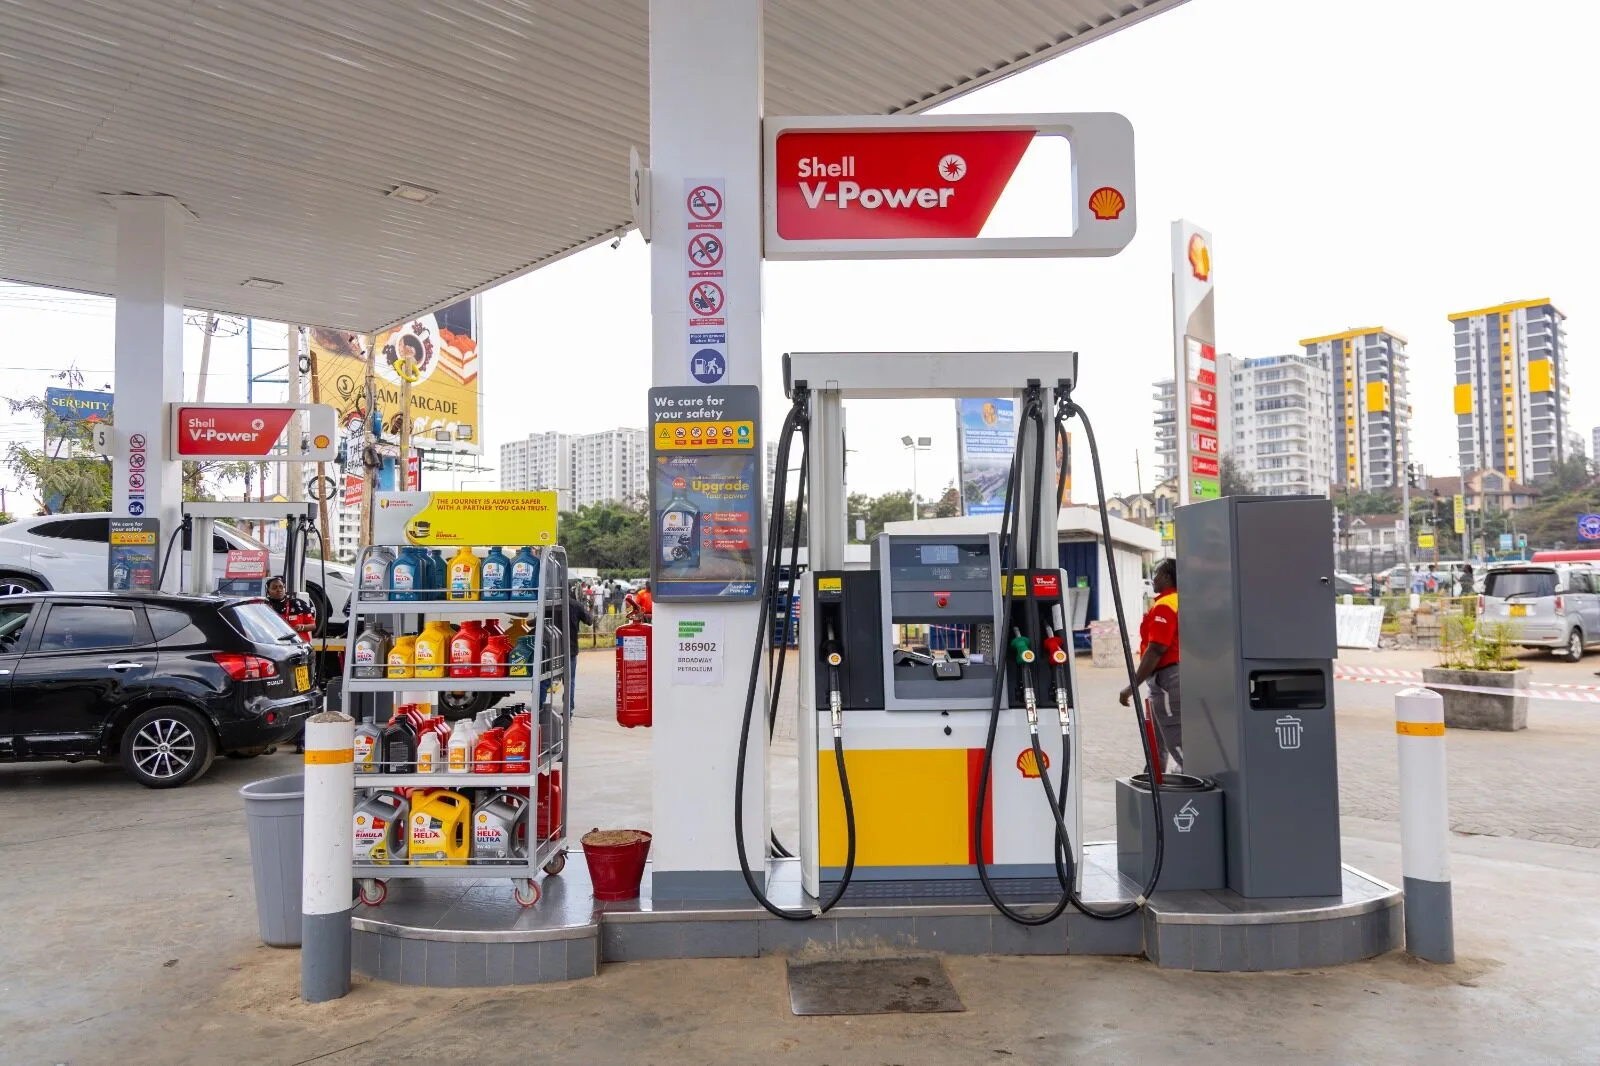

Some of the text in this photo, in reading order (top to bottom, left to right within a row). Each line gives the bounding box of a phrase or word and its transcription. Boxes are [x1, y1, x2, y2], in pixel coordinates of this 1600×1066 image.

[798, 156, 854, 177] Shell
[799, 181, 954, 209] V-Power
[52, 398, 109, 411] SERENITY
[410, 395, 458, 415] ARCADE
[654, 395, 725, 407] We care for
[655, 408, 723, 422] your safety
[188, 418, 215, 428] Shell
[98, 431, 105, 447] 5
[189, 429, 259, 442] V-Power
[692, 479, 750, 494] Upgrade
[679, 642, 716, 652] 186902
